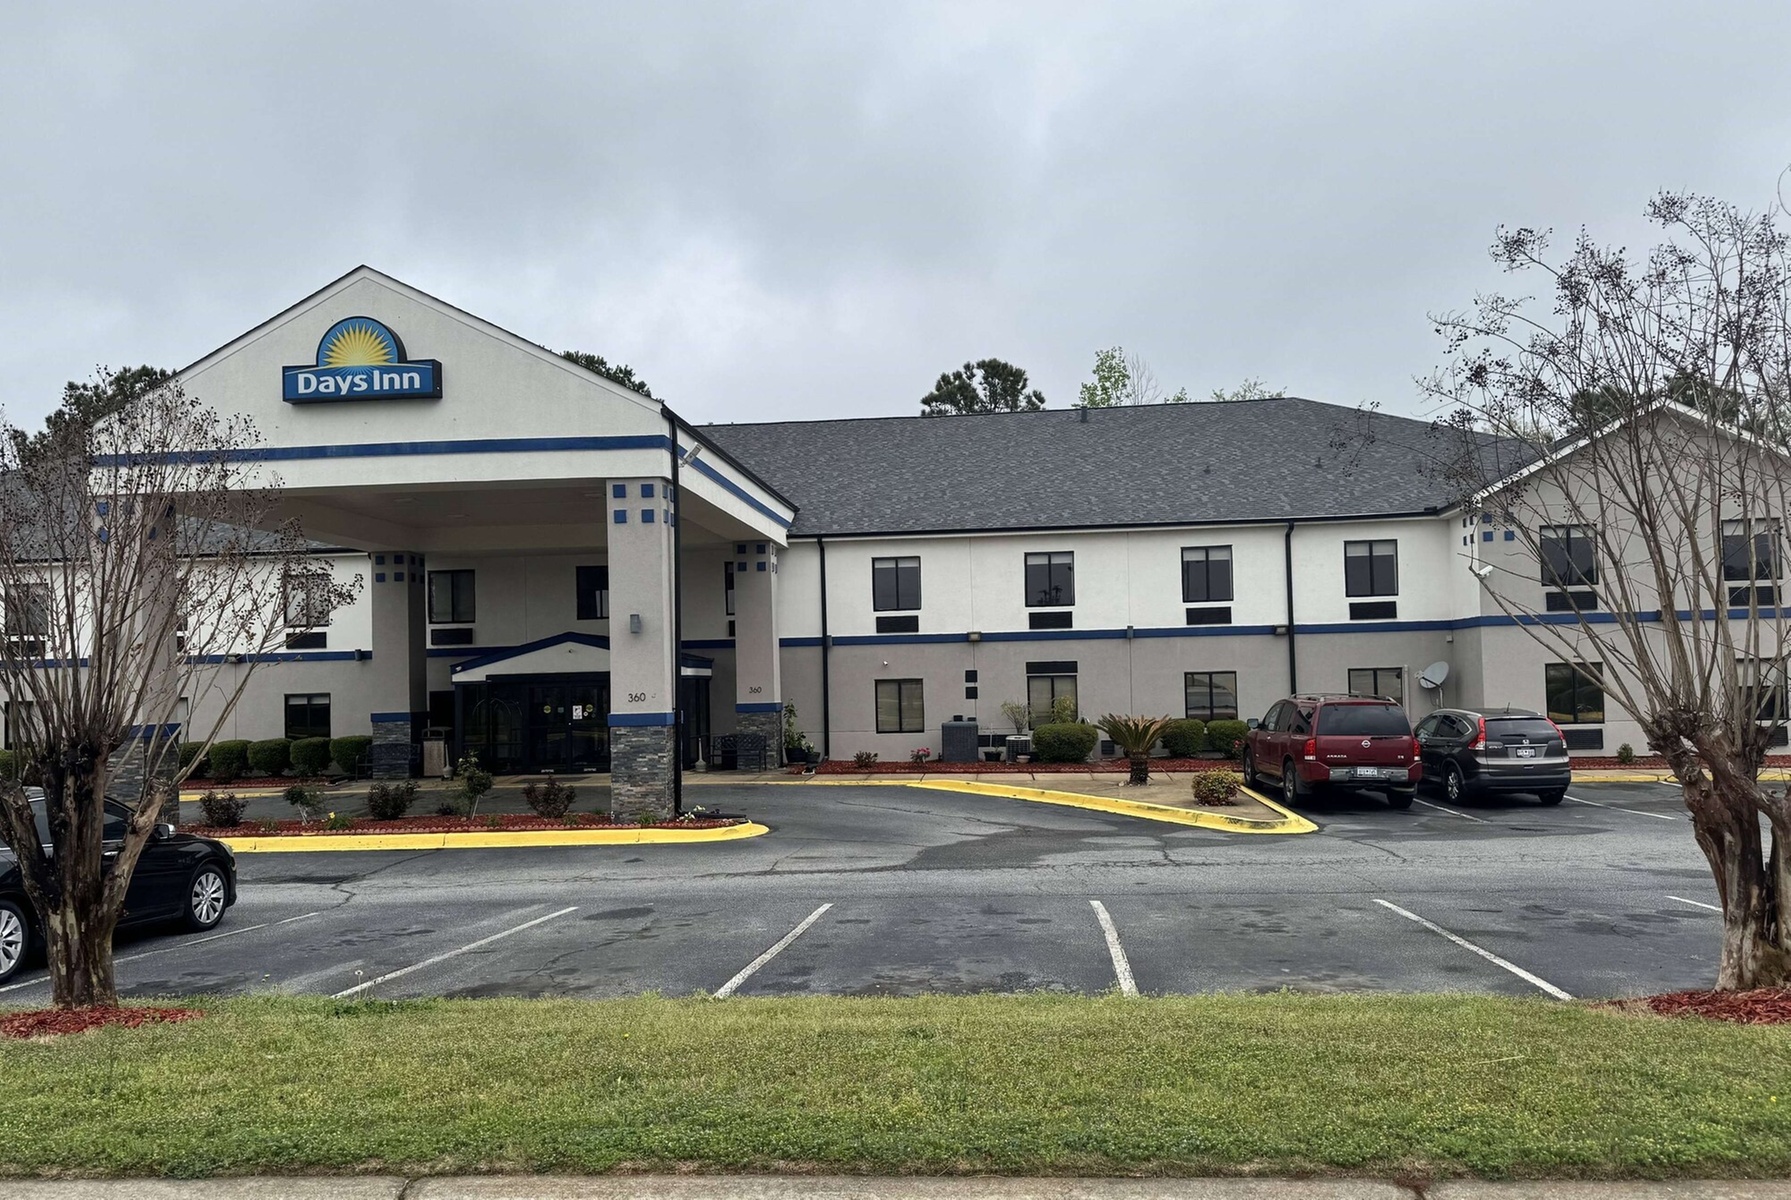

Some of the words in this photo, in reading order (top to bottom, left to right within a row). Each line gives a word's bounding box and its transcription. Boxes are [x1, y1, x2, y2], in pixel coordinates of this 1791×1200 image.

[298, 373, 367, 395] Days
[373, 370, 420, 390] Inn
[628, 692, 646, 703] 360
